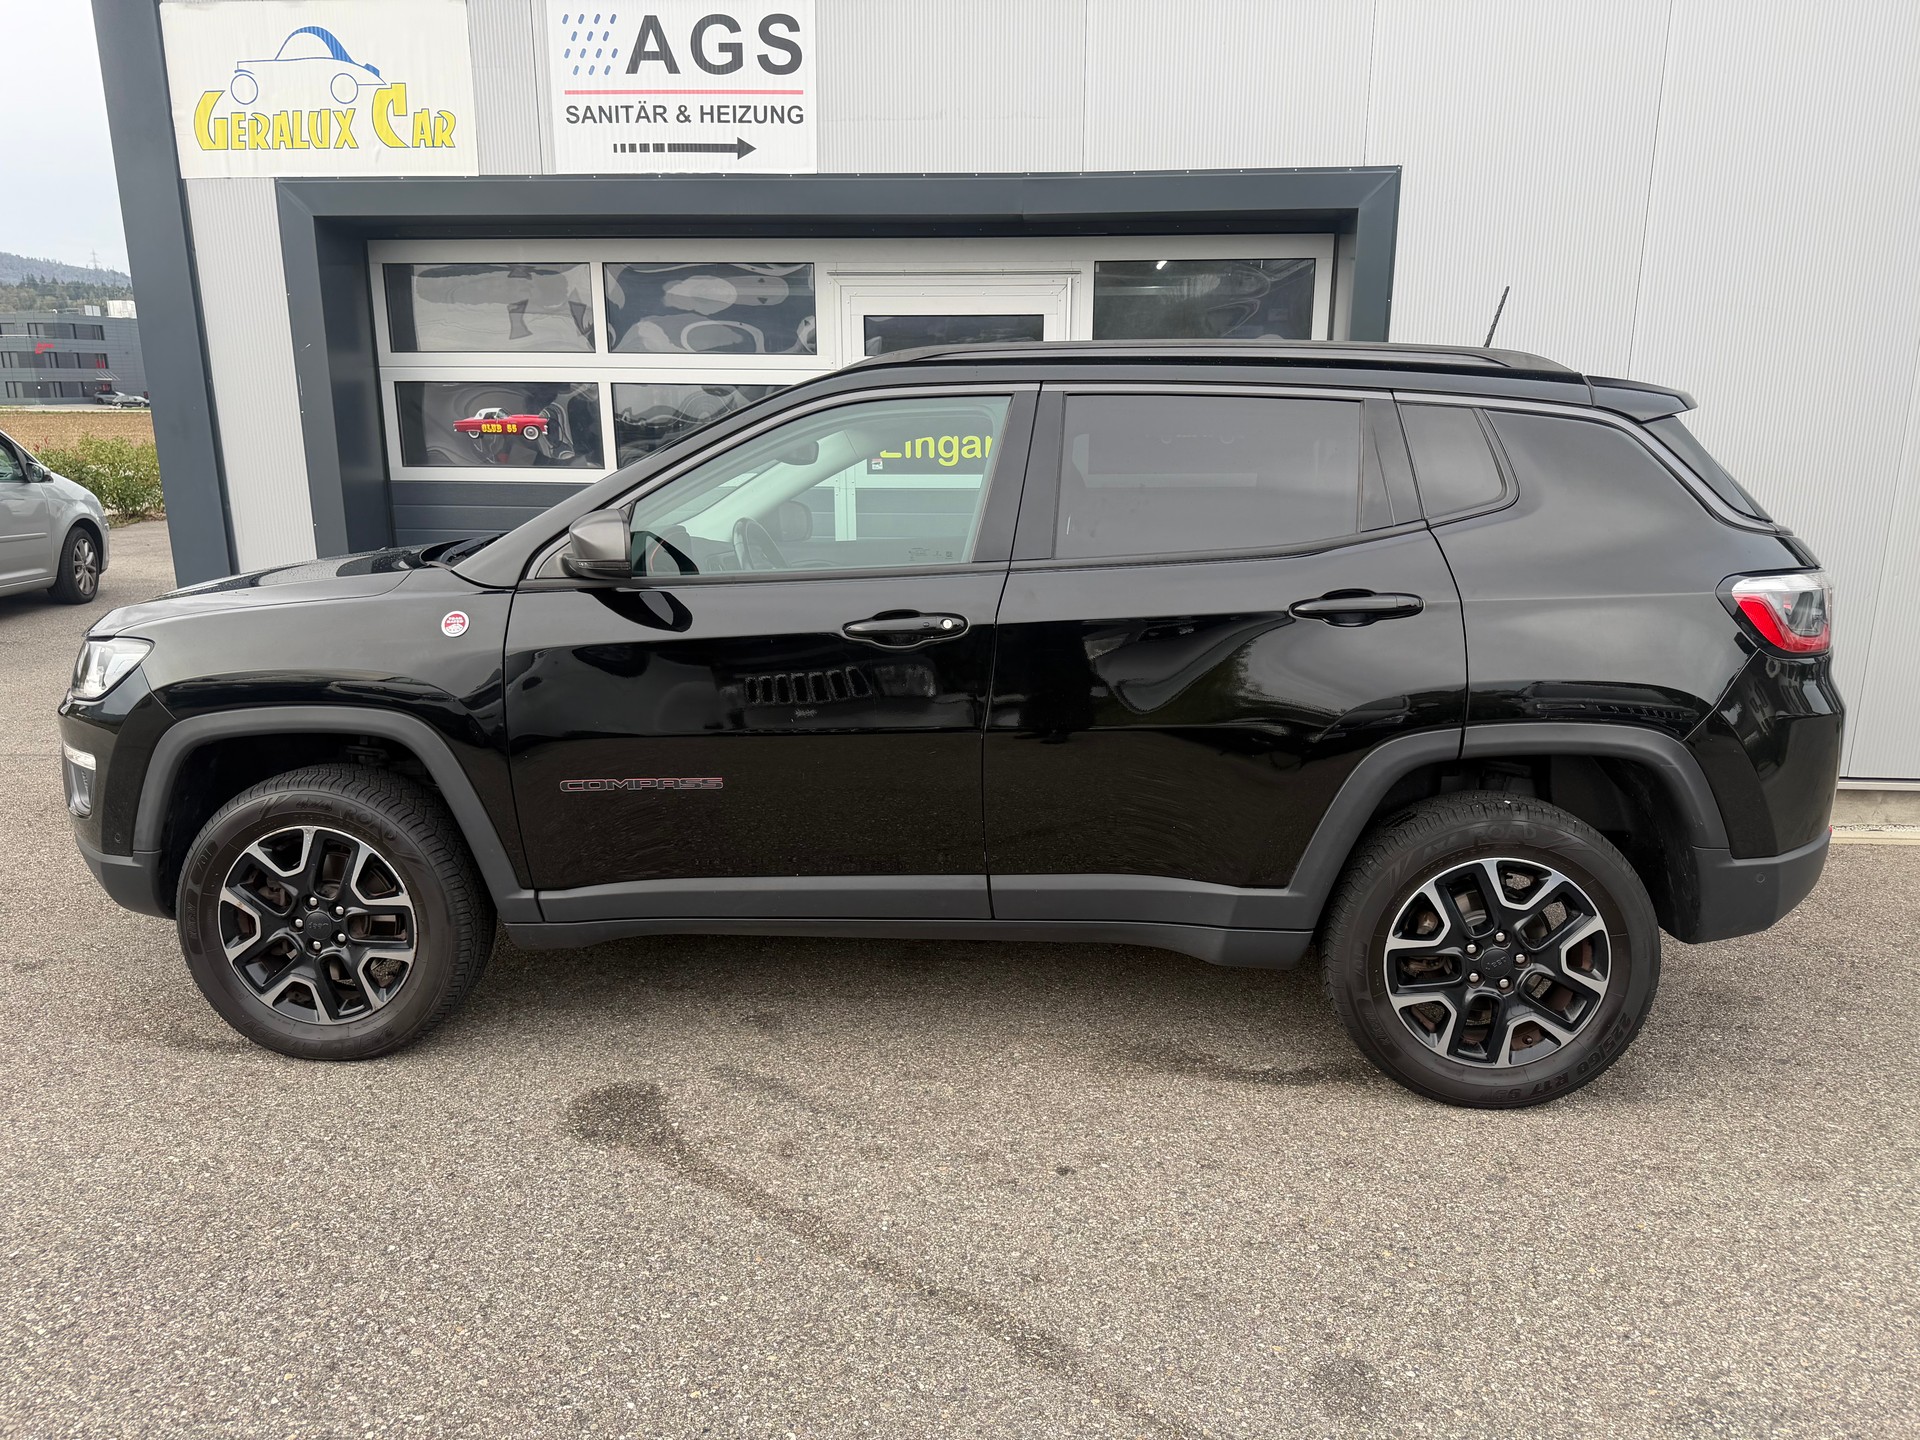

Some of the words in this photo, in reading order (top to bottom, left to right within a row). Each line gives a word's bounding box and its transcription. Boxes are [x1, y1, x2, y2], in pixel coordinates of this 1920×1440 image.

[625, 13, 803, 76] AGS
[565, 101, 668, 125] SANITÄR
[675, 105, 692, 124] &
[700, 105, 804, 125] HEIZUNG
[481, 423, 502, 433] CLUB
[506, 423, 517, 433] 55
[559, 777, 724, 792] COMPASS
